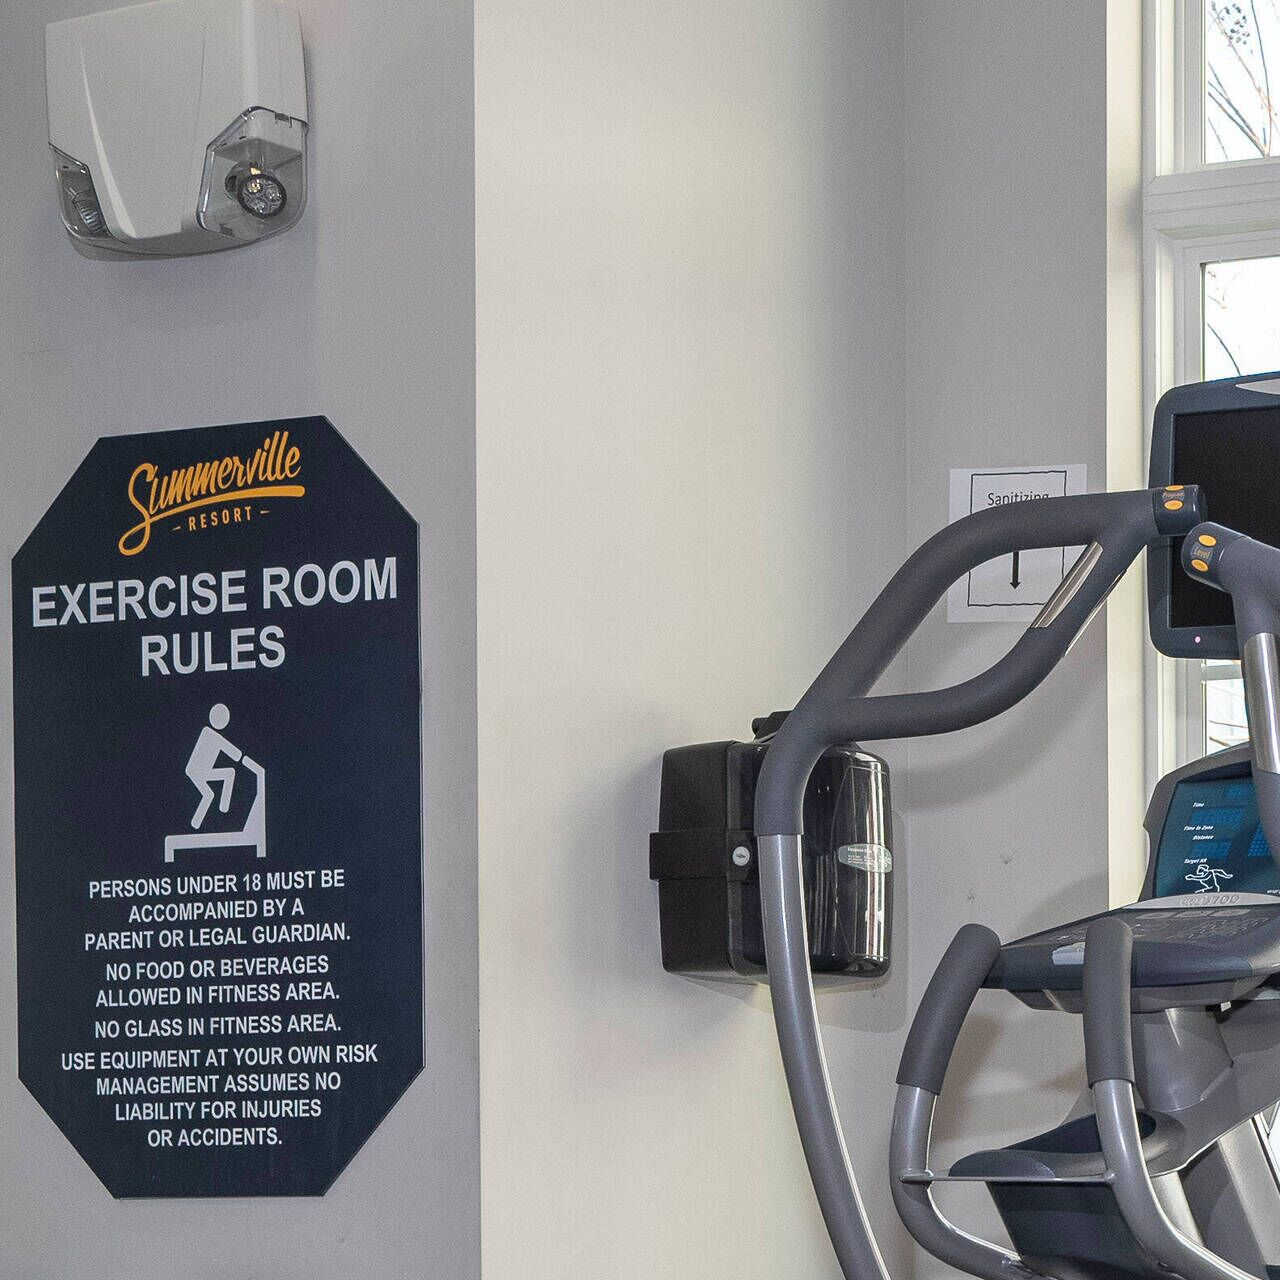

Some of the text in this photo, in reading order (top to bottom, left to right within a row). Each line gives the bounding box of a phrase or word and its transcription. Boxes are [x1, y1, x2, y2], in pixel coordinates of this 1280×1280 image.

[118, 430, 305, 556] Summerville
[189, 506, 252, 531] RESORT
[33, 557, 397, 627] EXERCISE ROOM
[142, 626, 285, 676] RULES
[90, 869, 344, 898] PERSONS UNDER 18 MUST BE
[129, 898, 304, 923] ACCOMPANIED BY A
[85, 923, 350, 950] PARENT OR LEGAL GUARDIAN.
[107, 955, 328, 980] NO FOOD OR BEVERAGES
[96, 982, 339, 1007] ALLOWED IN FITNESS AREA.
[96, 1014, 341, 1038] NO GLASS IN FITNESS AREA.
[62, 1044, 377, 1070] USE EQUIPMENT AT YOUR OWN RISK
[97, 1072, 340, 1095] MANAGEMENT ASSUMES NO
[116, 1099, 321, 1120] LIABILITY FOR INJURIES
[148, 1127, 282, 1147] OR ACCIDENTS.
